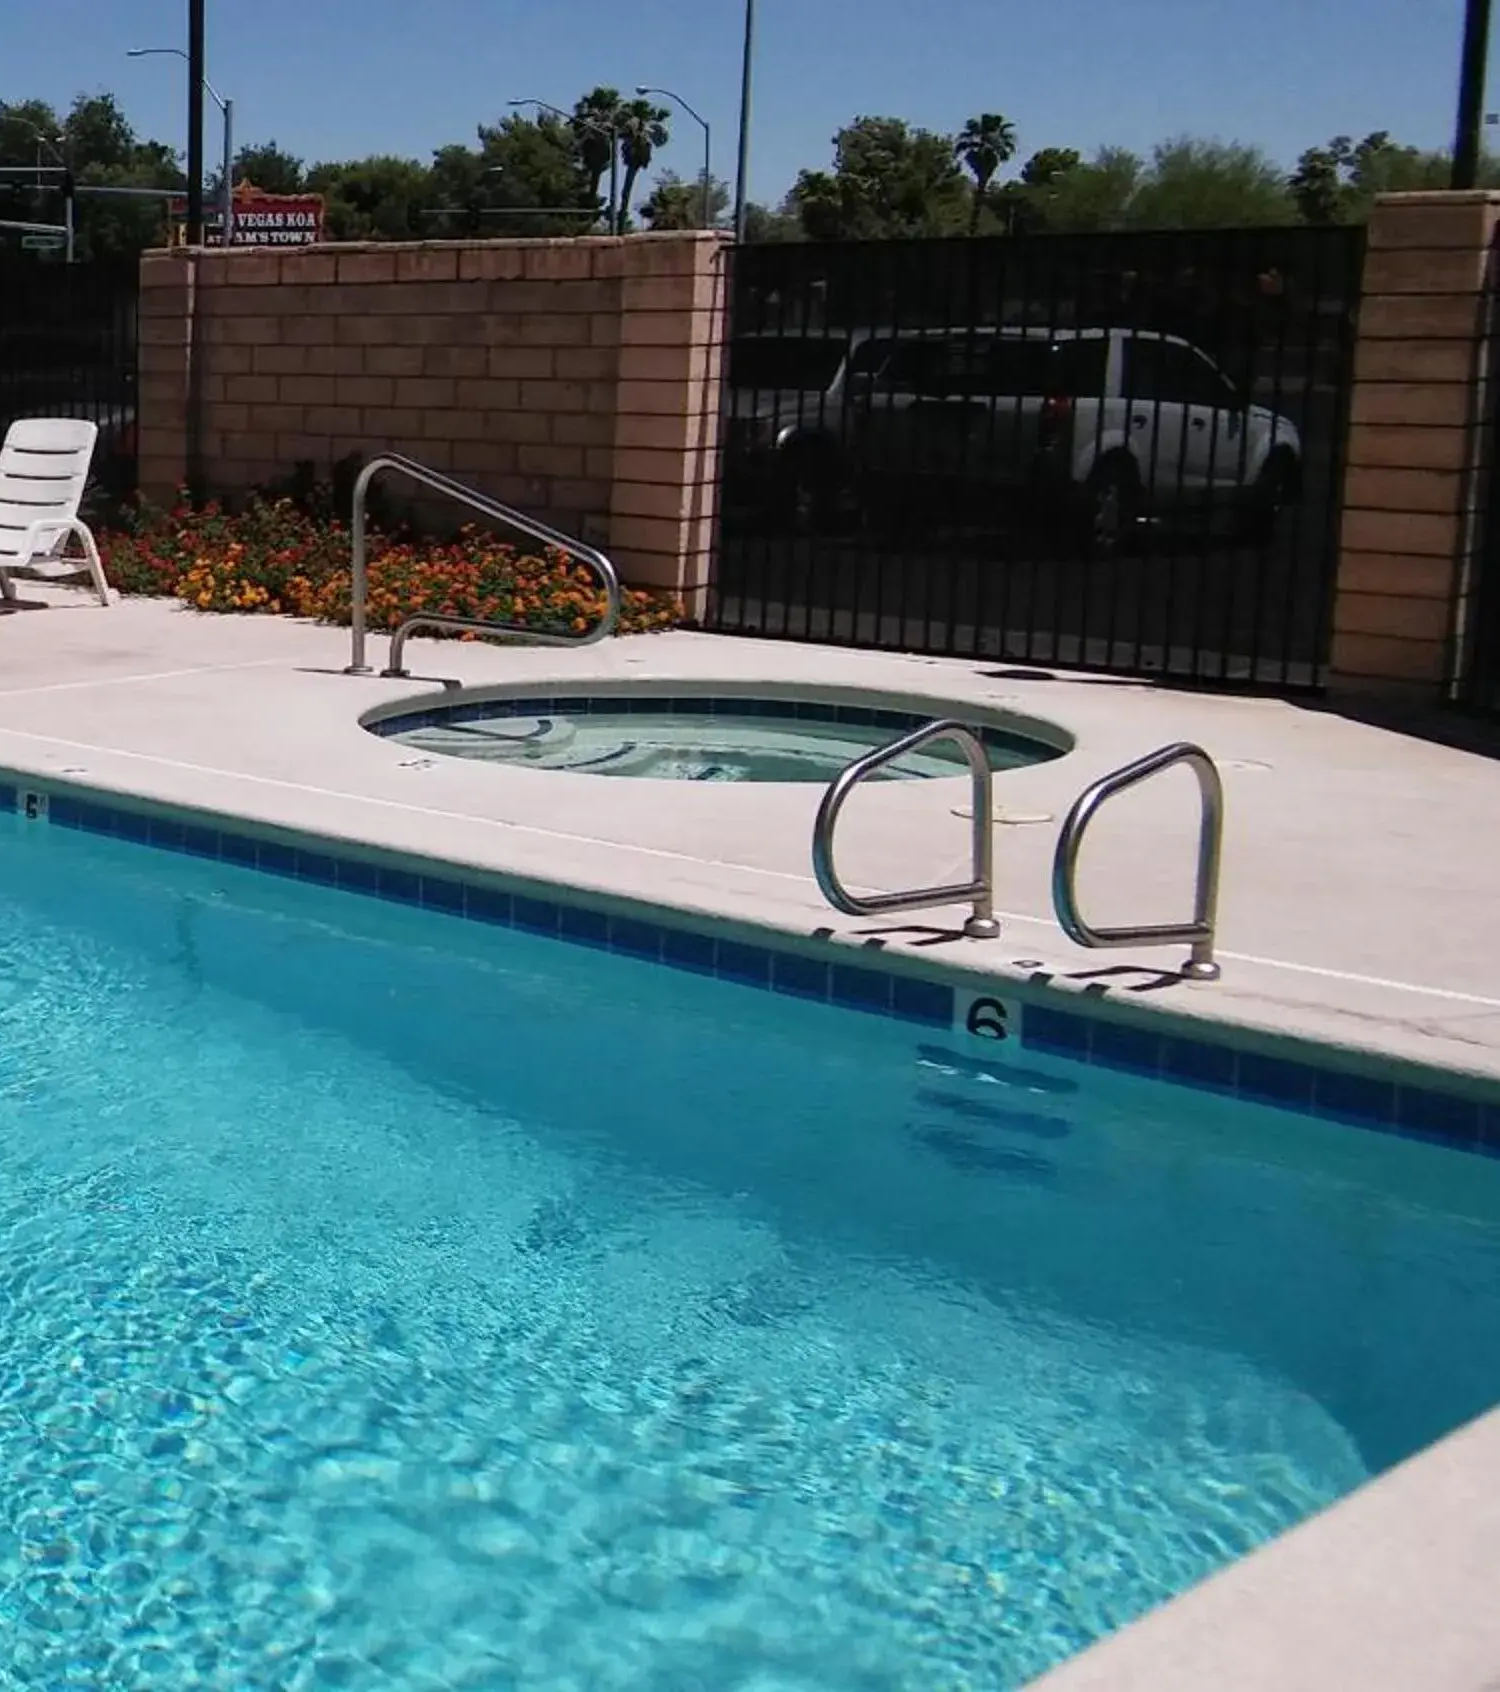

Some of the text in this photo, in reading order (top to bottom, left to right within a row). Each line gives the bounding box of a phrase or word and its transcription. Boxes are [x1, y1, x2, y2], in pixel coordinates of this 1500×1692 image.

[237, 213, 283, 227] VEGAS
[286, 212, 316, 227] KOA
[235, 231, 269, 242] AM'S
[270, 231, 315, 242] TOWN
[966, 996, 1008, 1040] 6
